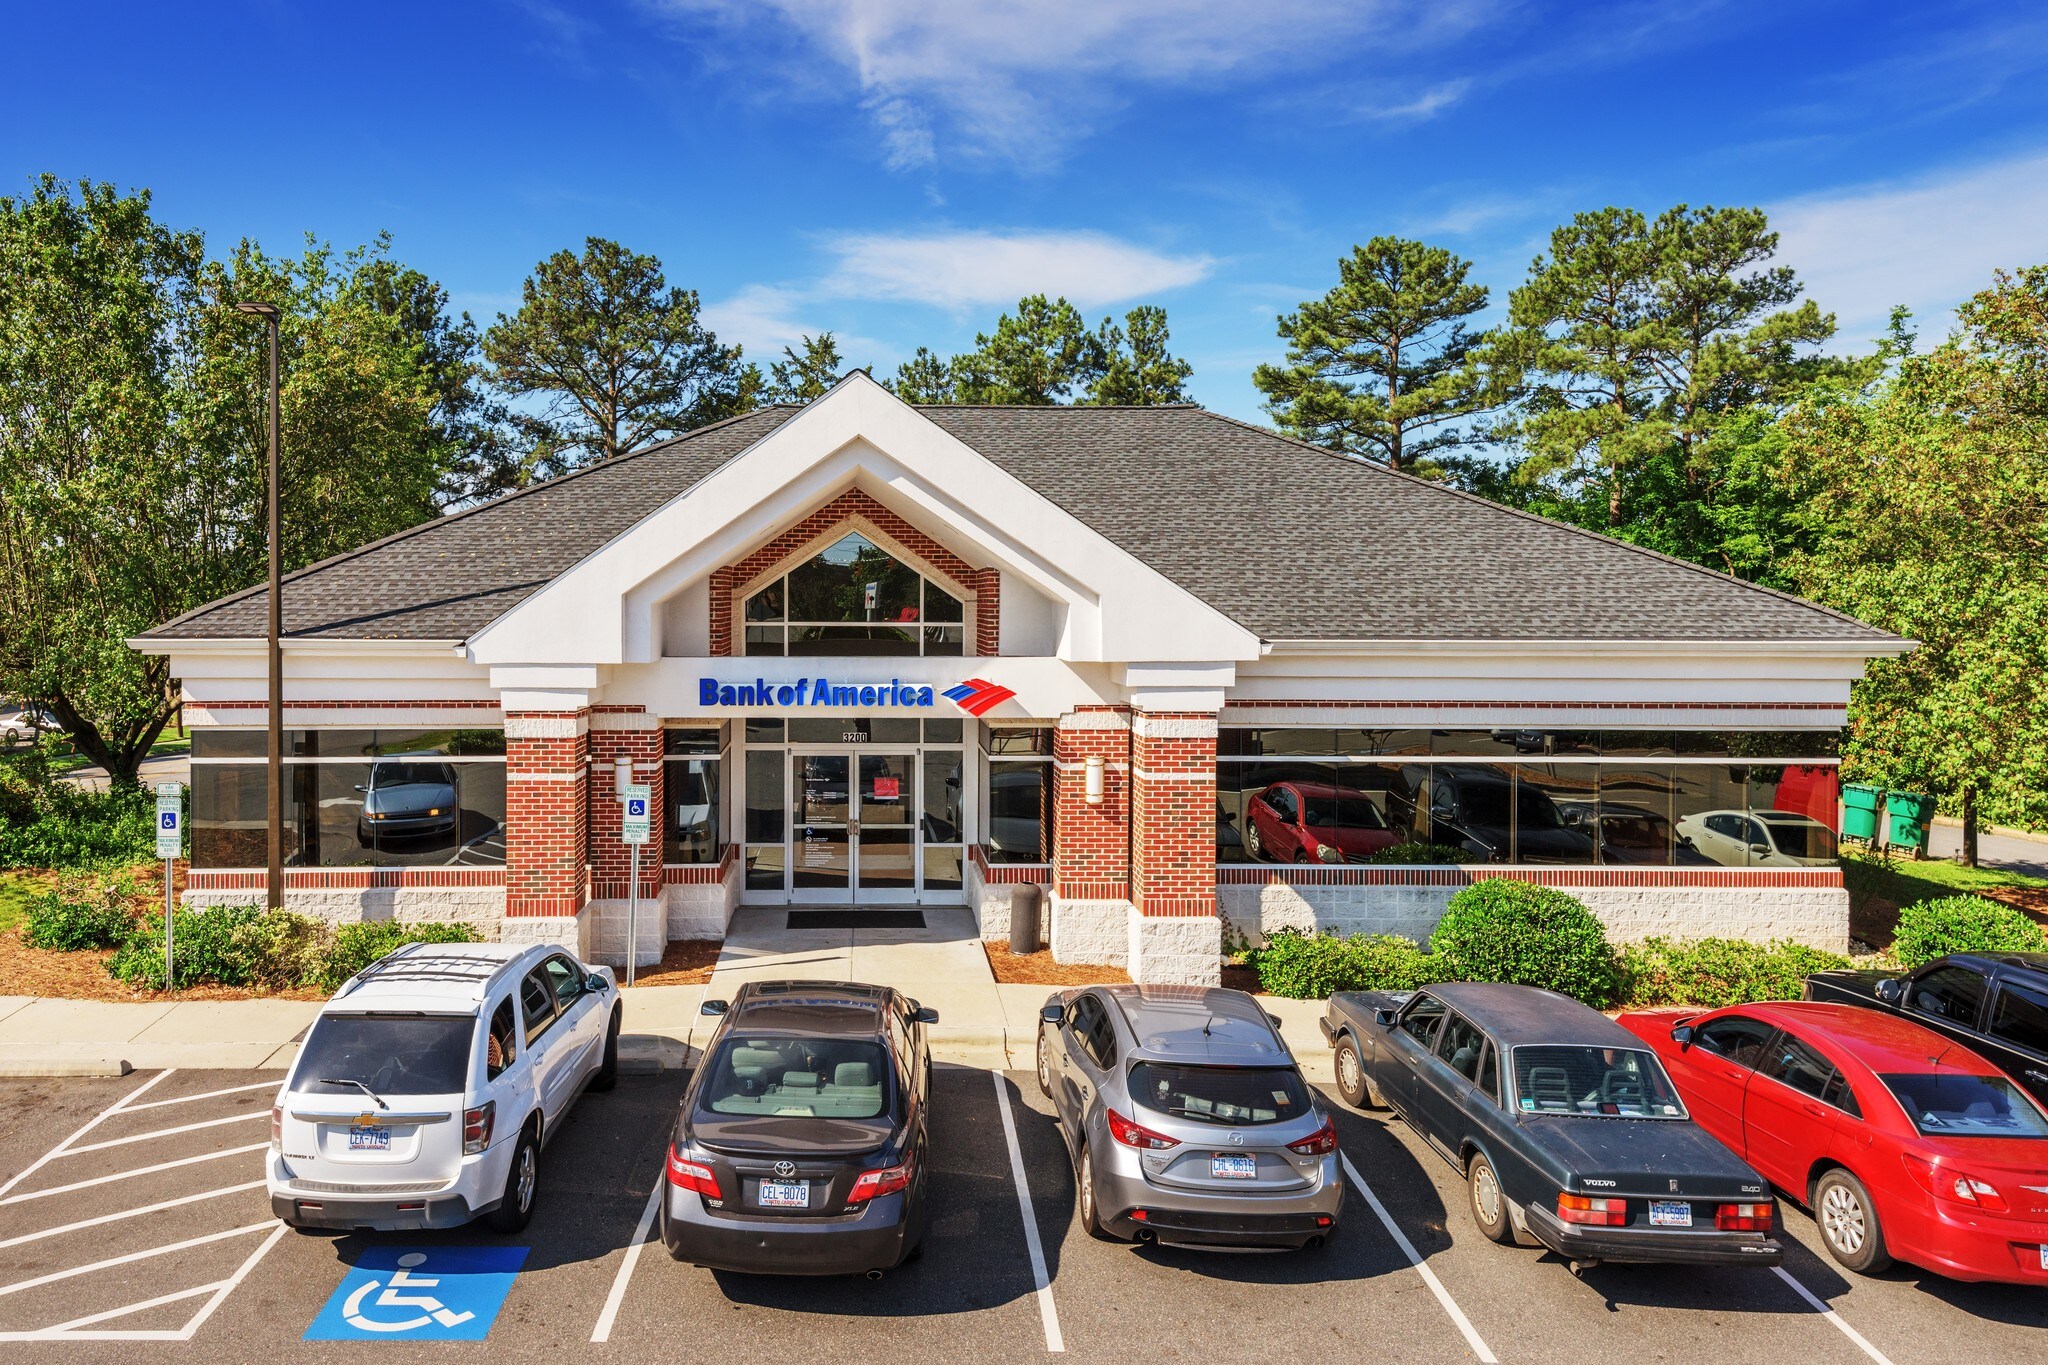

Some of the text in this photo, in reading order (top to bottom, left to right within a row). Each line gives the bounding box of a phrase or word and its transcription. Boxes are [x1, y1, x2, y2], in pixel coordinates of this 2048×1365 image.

[699, 678, 934, 706] Bank of America
[844, 733, 866, 742] 3200
[350, 1132, 389, 1145] CEK-7749
[1583, 1179, 1616, 1187] VOLVO
[762, 1186, 806, 1200] CEL-8078
